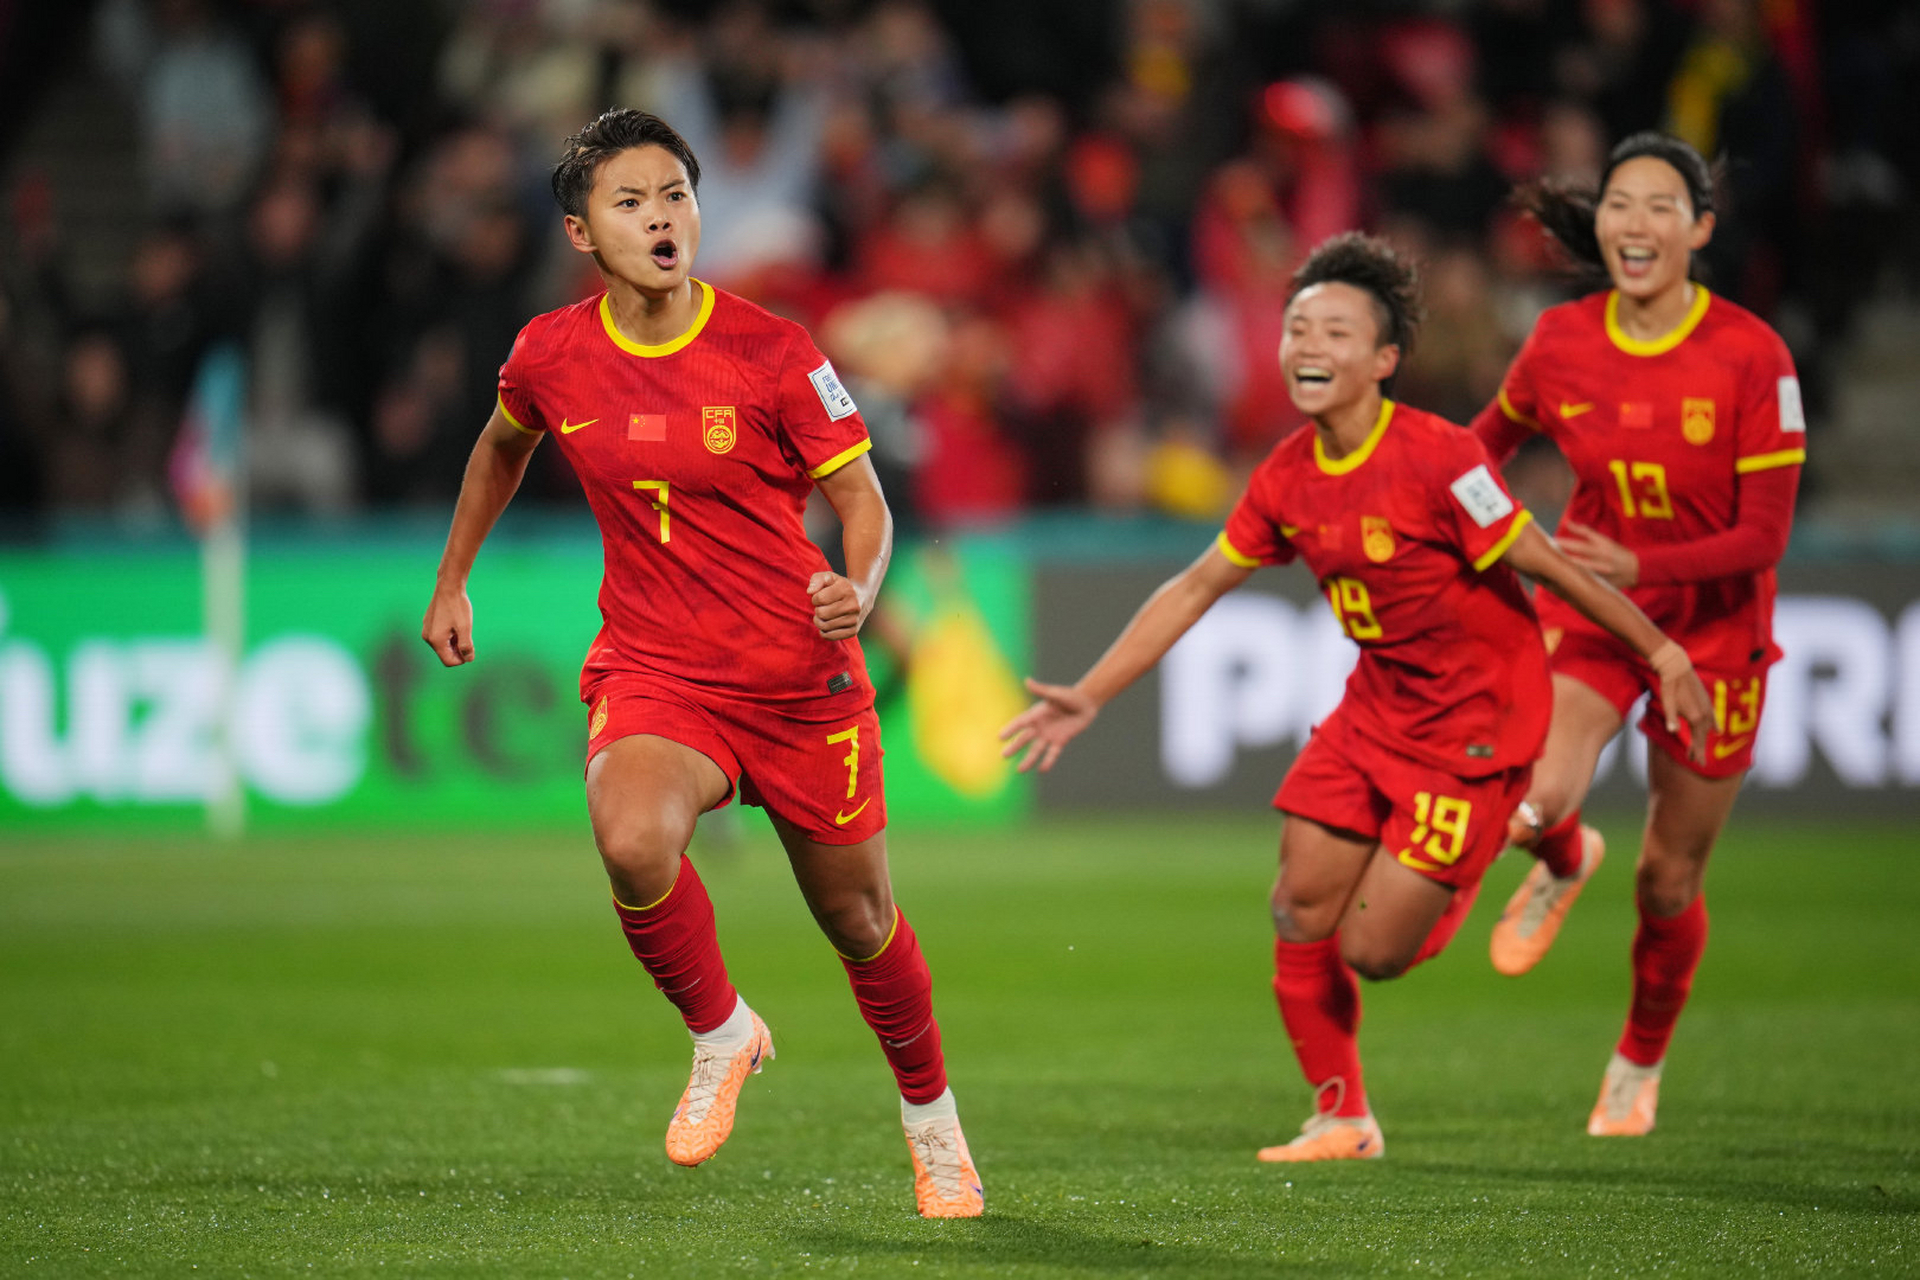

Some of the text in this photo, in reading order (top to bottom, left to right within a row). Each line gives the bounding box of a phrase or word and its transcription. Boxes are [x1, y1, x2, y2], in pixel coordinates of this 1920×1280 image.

[705, 409, 733, 419] CFA
[633, 480, 670, 544] 7
[1609, 459, 1674, 520] 13
[1324, 577, 1382, 639] 19
[0, 615, 590, 808] uze te
[1713, 676, 1761, 735] 13
[826, 725, 860, 799] 7
[1410, 791, 1472, 865] 19
